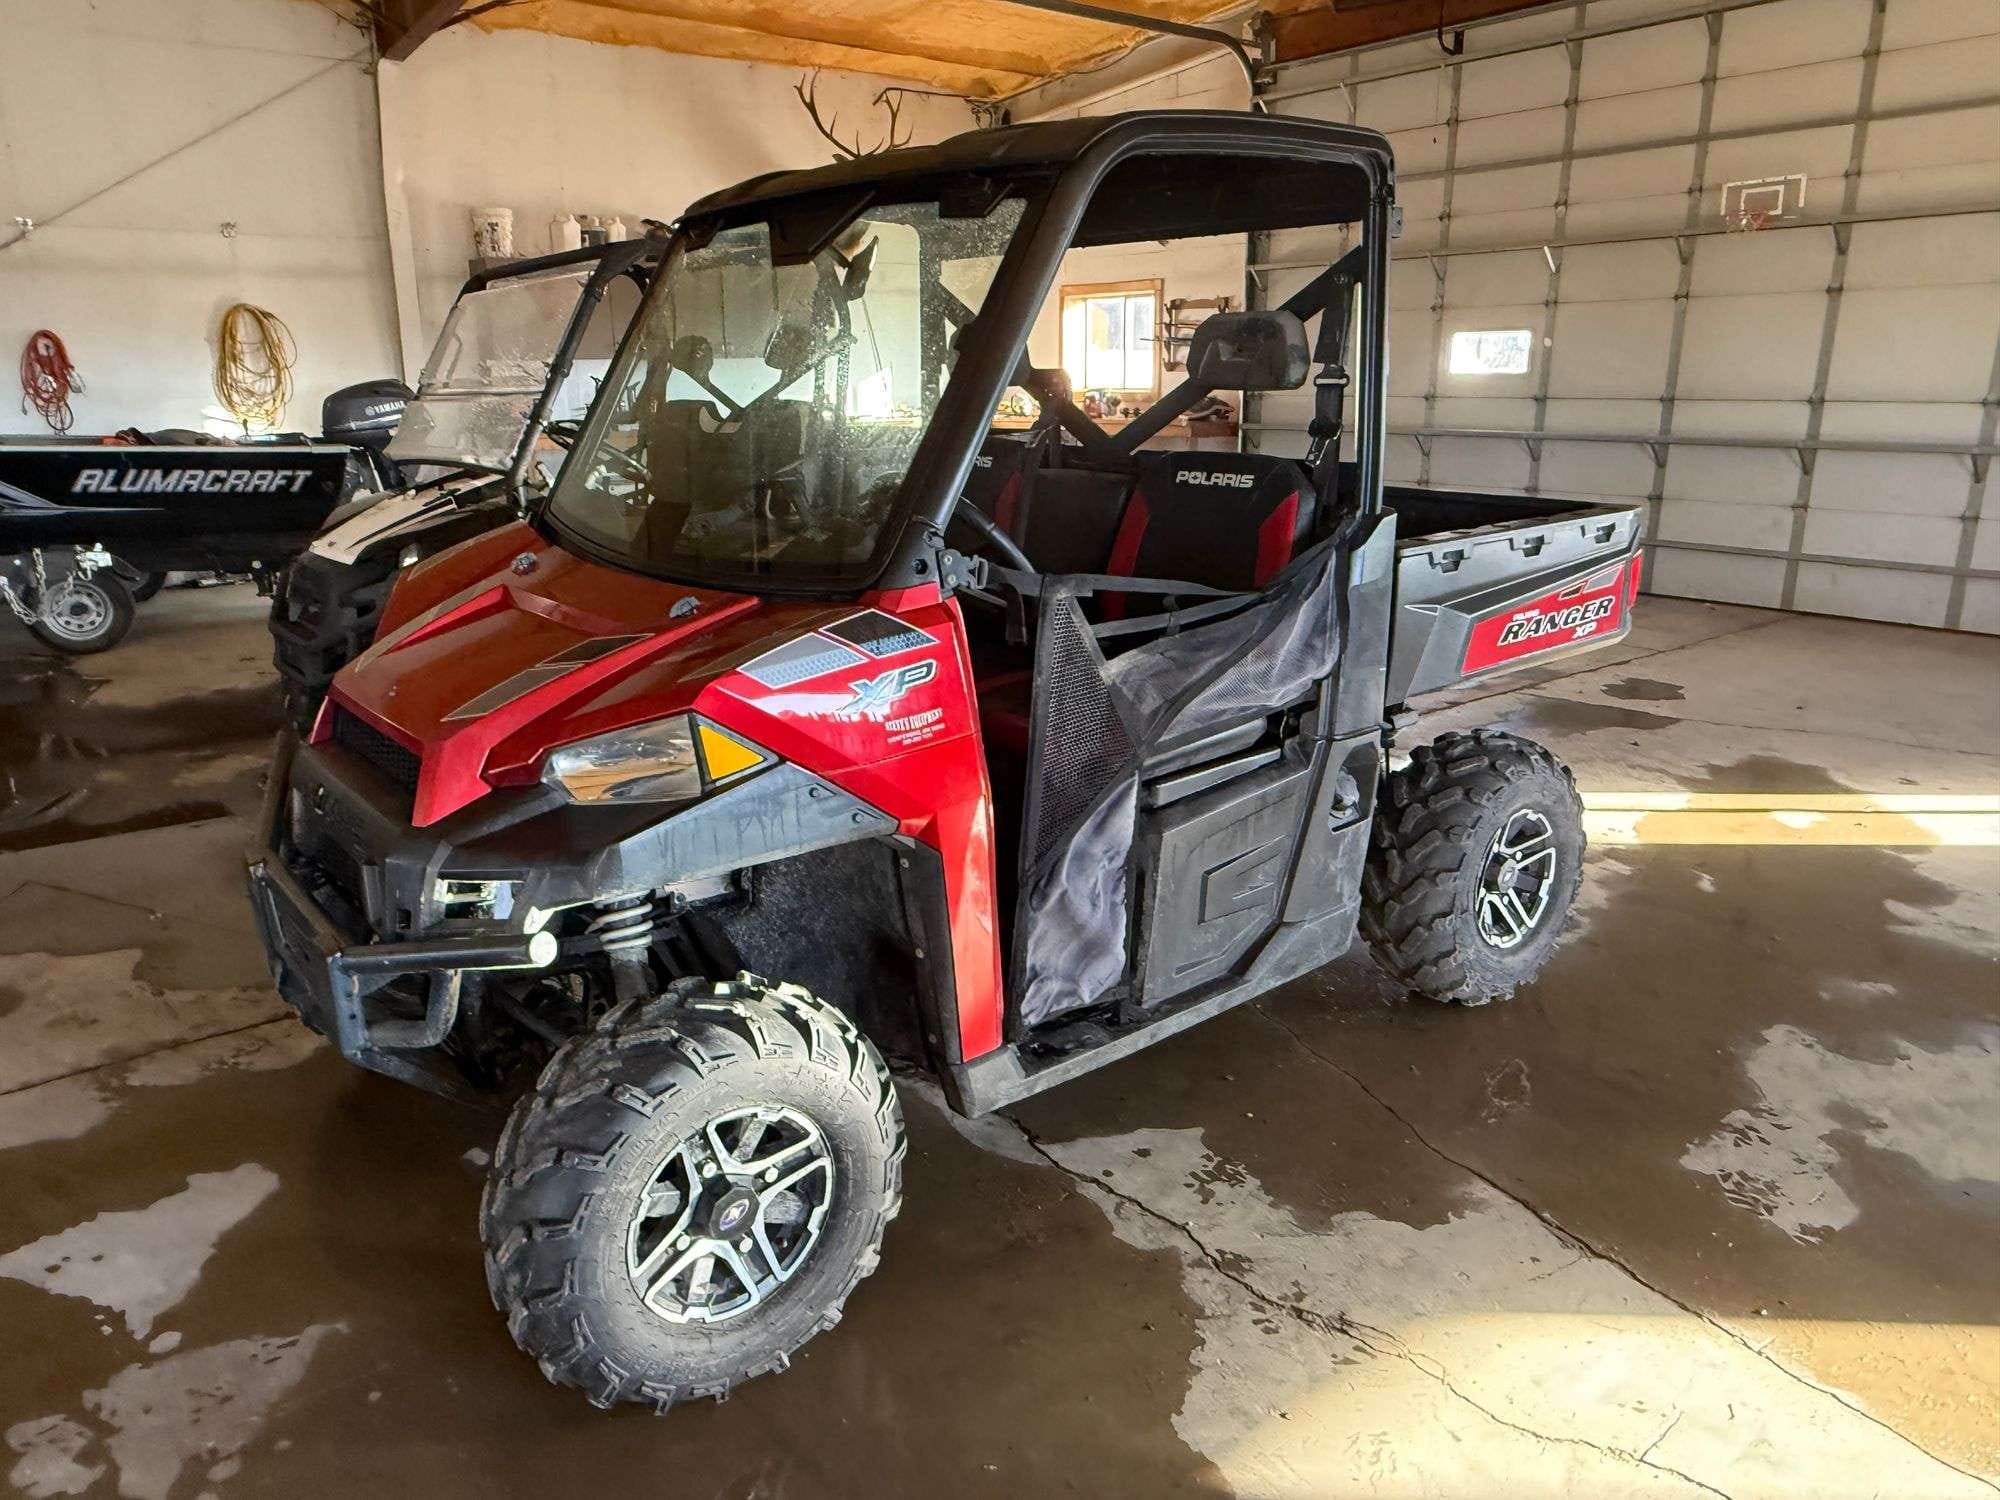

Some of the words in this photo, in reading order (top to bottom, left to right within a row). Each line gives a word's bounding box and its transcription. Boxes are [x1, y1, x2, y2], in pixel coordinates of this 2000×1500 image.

[373, 400, 407, 414] YAMAHA
[71, 469, 312, 493] ALUMACRAFT
[1175, 470, 1255, 488] POLARIS
[1497, 596, 1615, 646] RANGER
[1572, 622, 1597, 639] XP
[845, 658, 937, 710] XP
